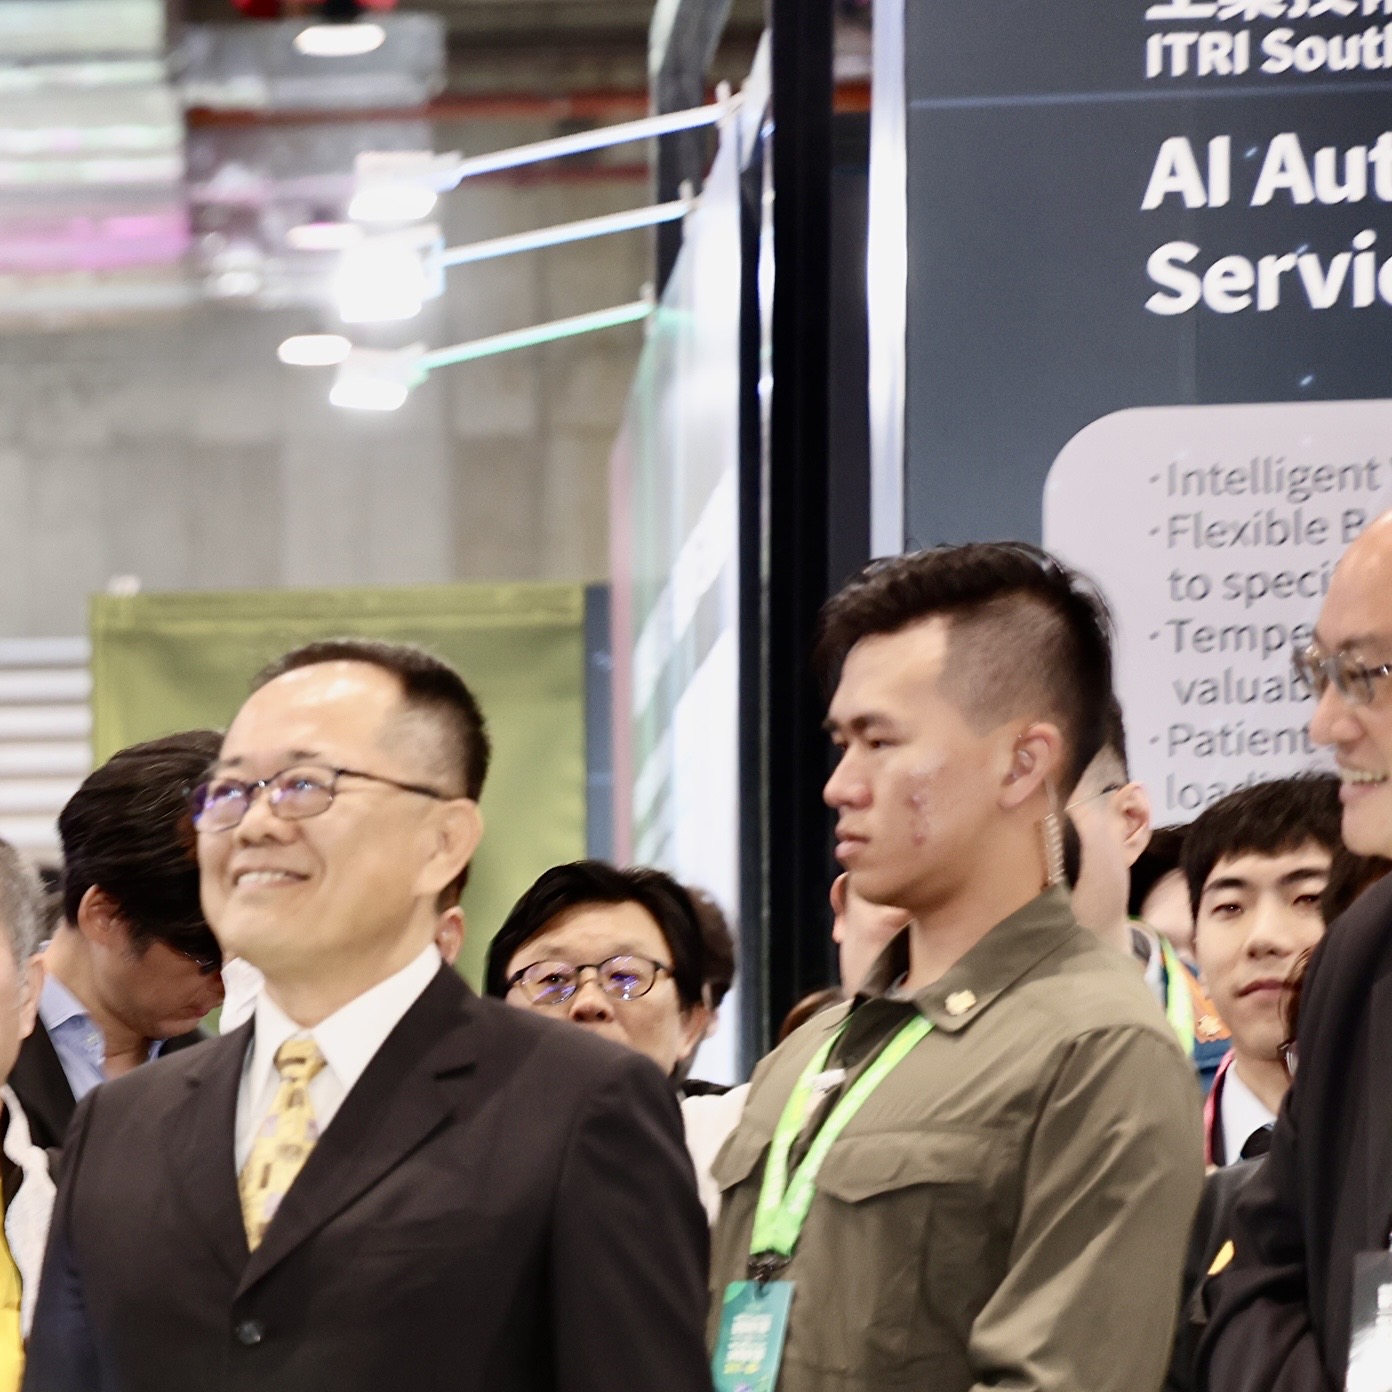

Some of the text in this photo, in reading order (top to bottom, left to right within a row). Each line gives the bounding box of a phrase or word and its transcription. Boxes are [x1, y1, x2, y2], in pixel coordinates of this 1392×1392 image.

[1146, 22, 1392, 78] ITRI Sout
[1140, 134, 1231, 210] AI
[1167, 455, 1383, 503] Intelligent
[1167, 508, 1329, 549] Flexible
[1167, 559, 1336, 608] to speci
